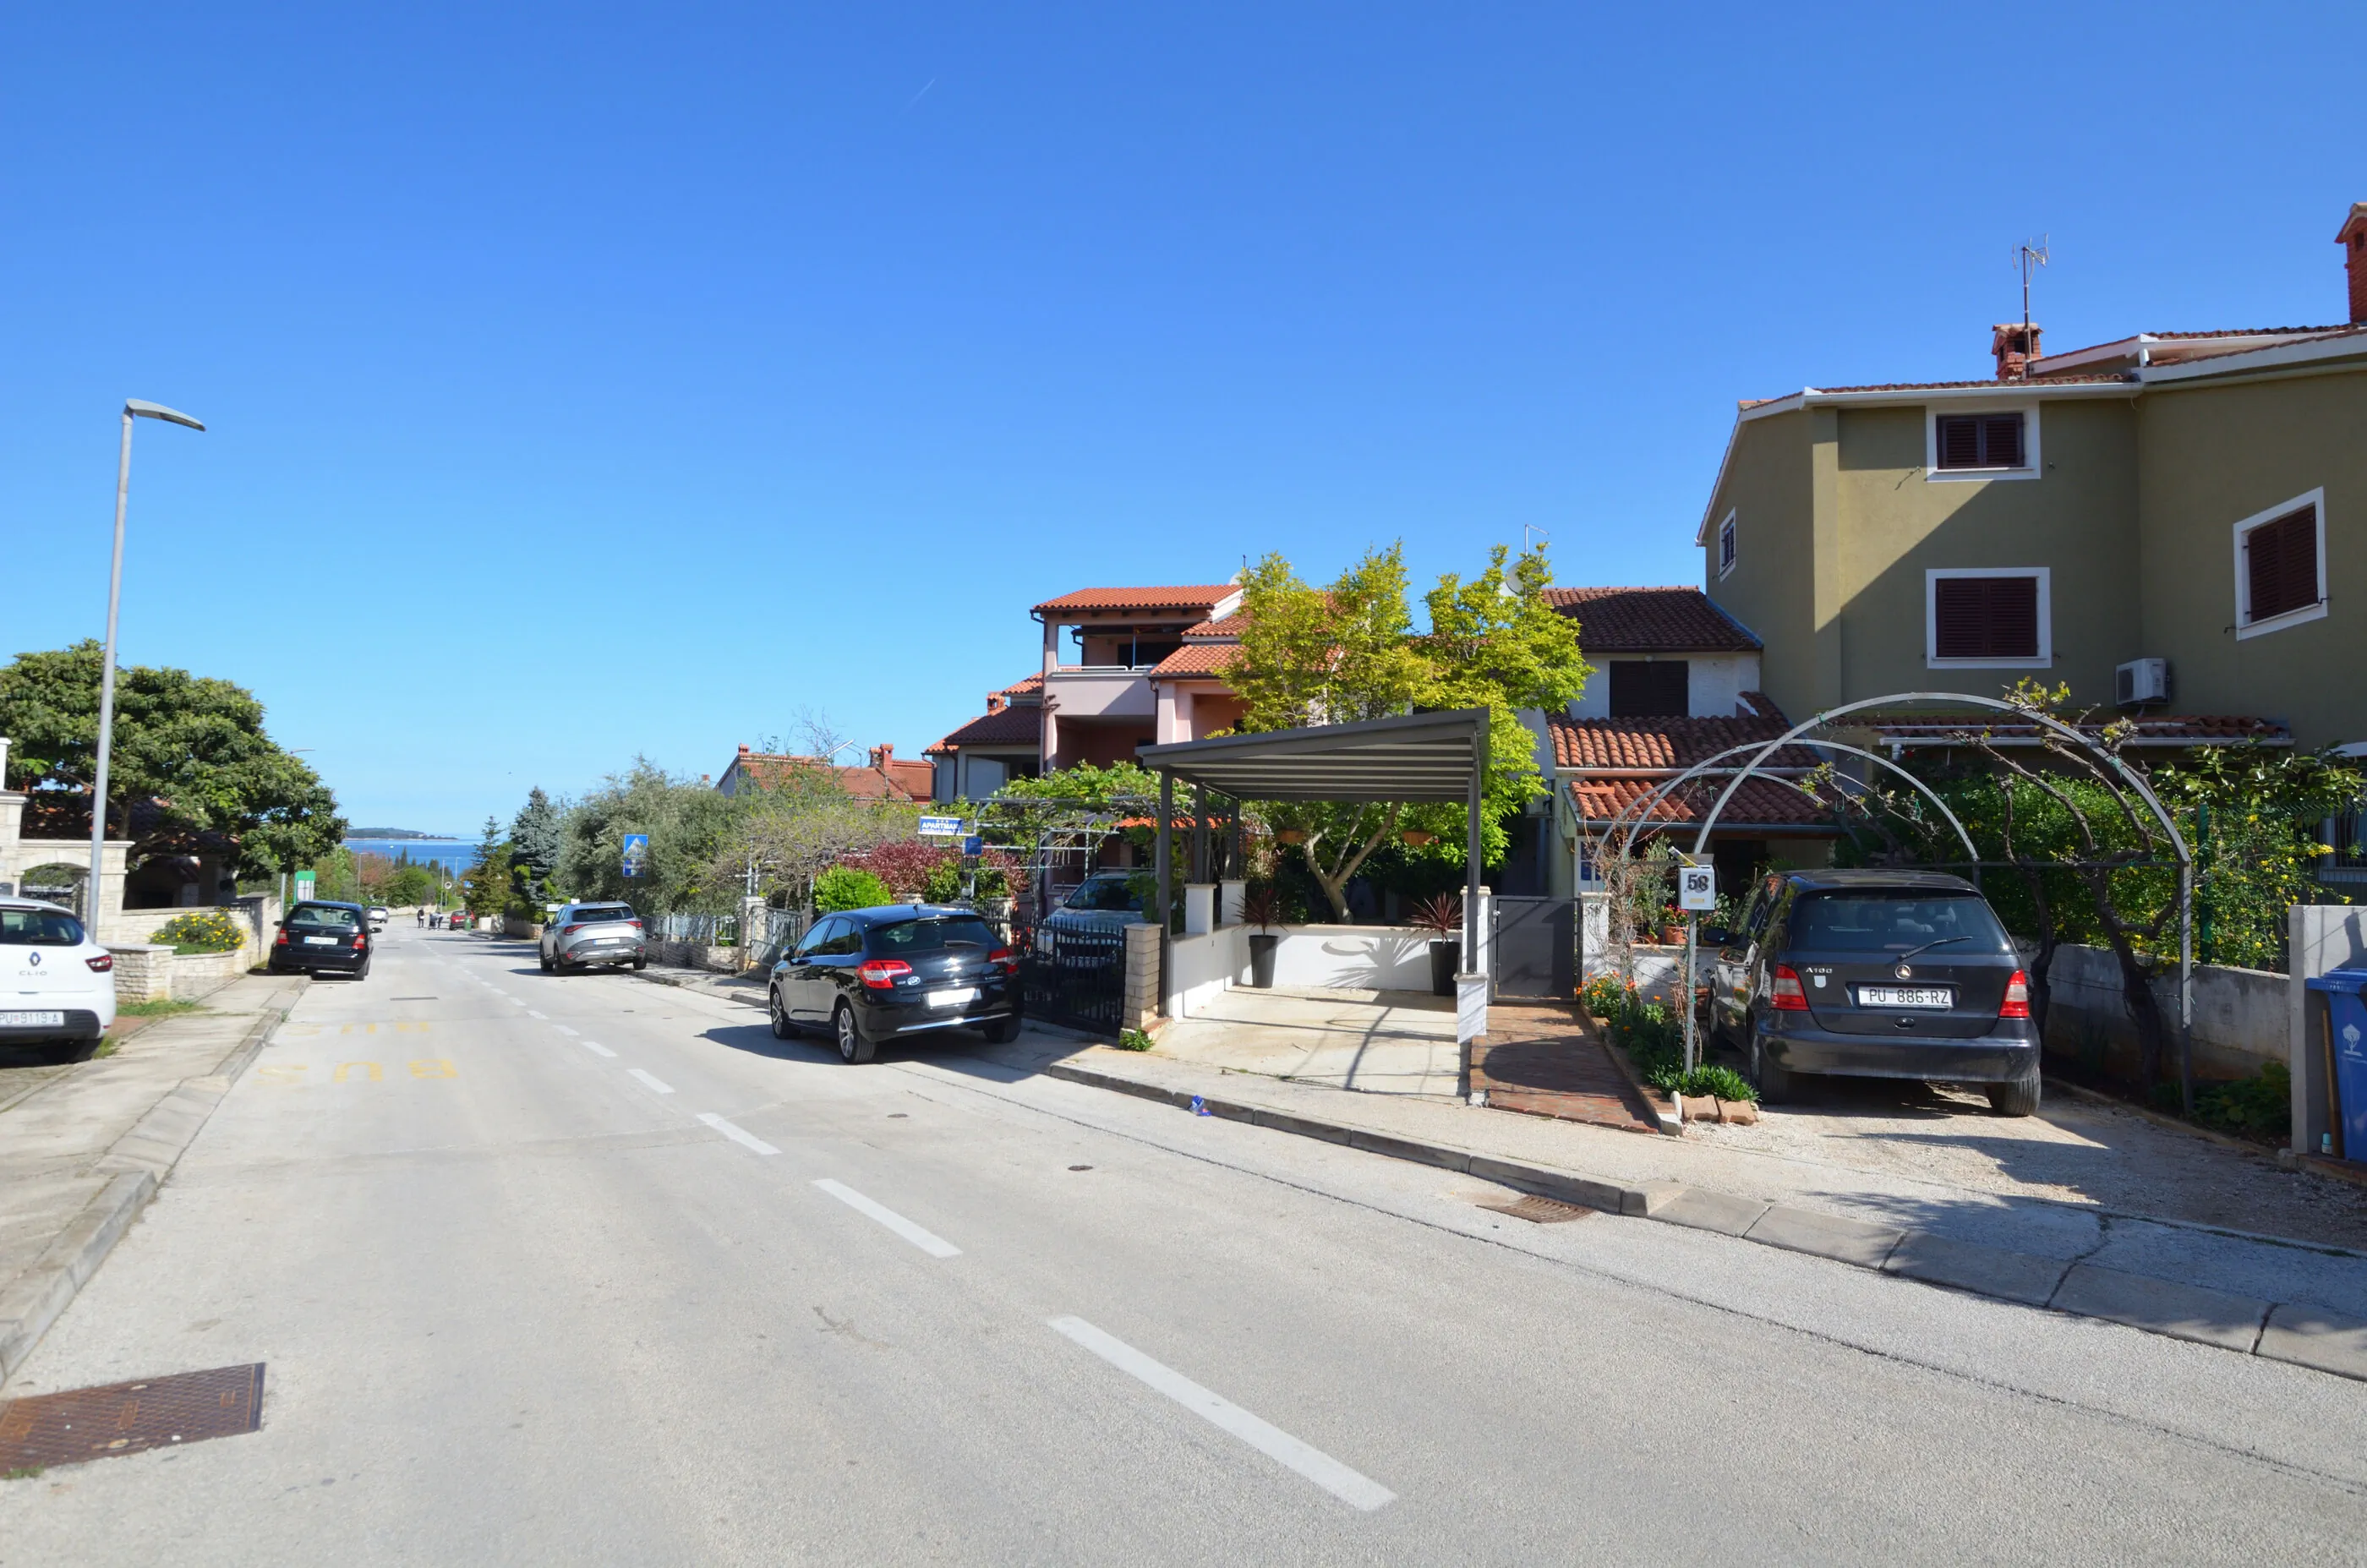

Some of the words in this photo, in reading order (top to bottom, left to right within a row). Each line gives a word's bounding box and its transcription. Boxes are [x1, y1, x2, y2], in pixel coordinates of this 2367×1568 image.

[1687, 874, 1708, 891] 58
[1869, 989, 1886, 1002] PU
[1897, 990, 1949, 1003] 886-RZ
